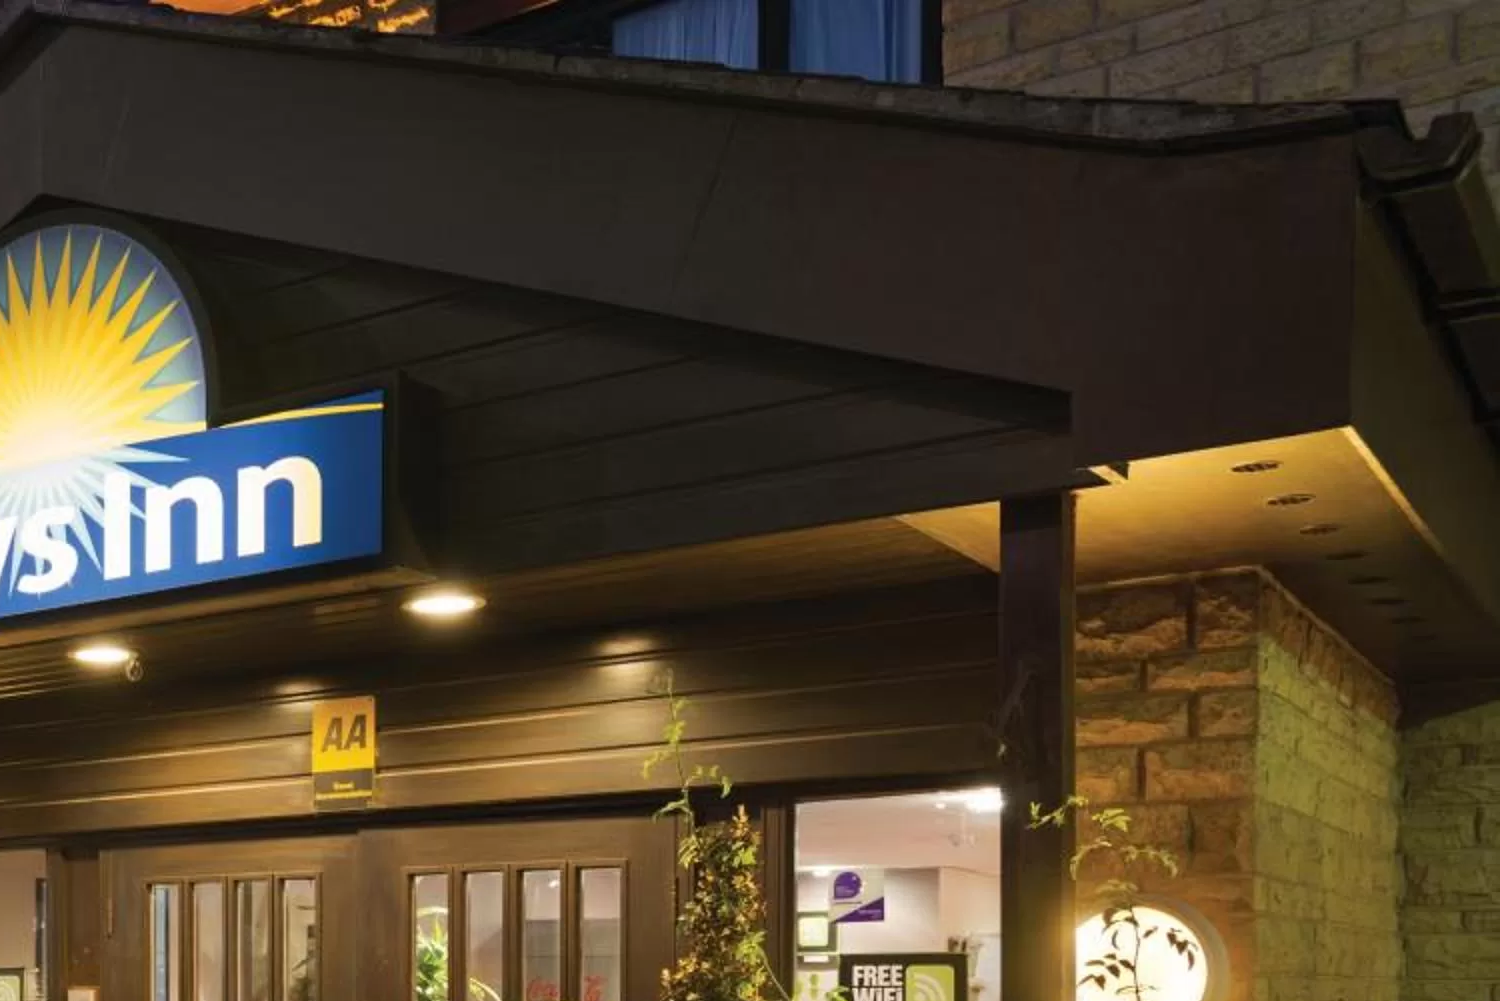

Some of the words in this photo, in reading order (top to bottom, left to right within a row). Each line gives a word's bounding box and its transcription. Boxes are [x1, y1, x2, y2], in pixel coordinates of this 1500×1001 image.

[103, 456, 323, 580] Inn
[321, 714, 367, 752] AA
[852, 965, 904, 987] FREE
